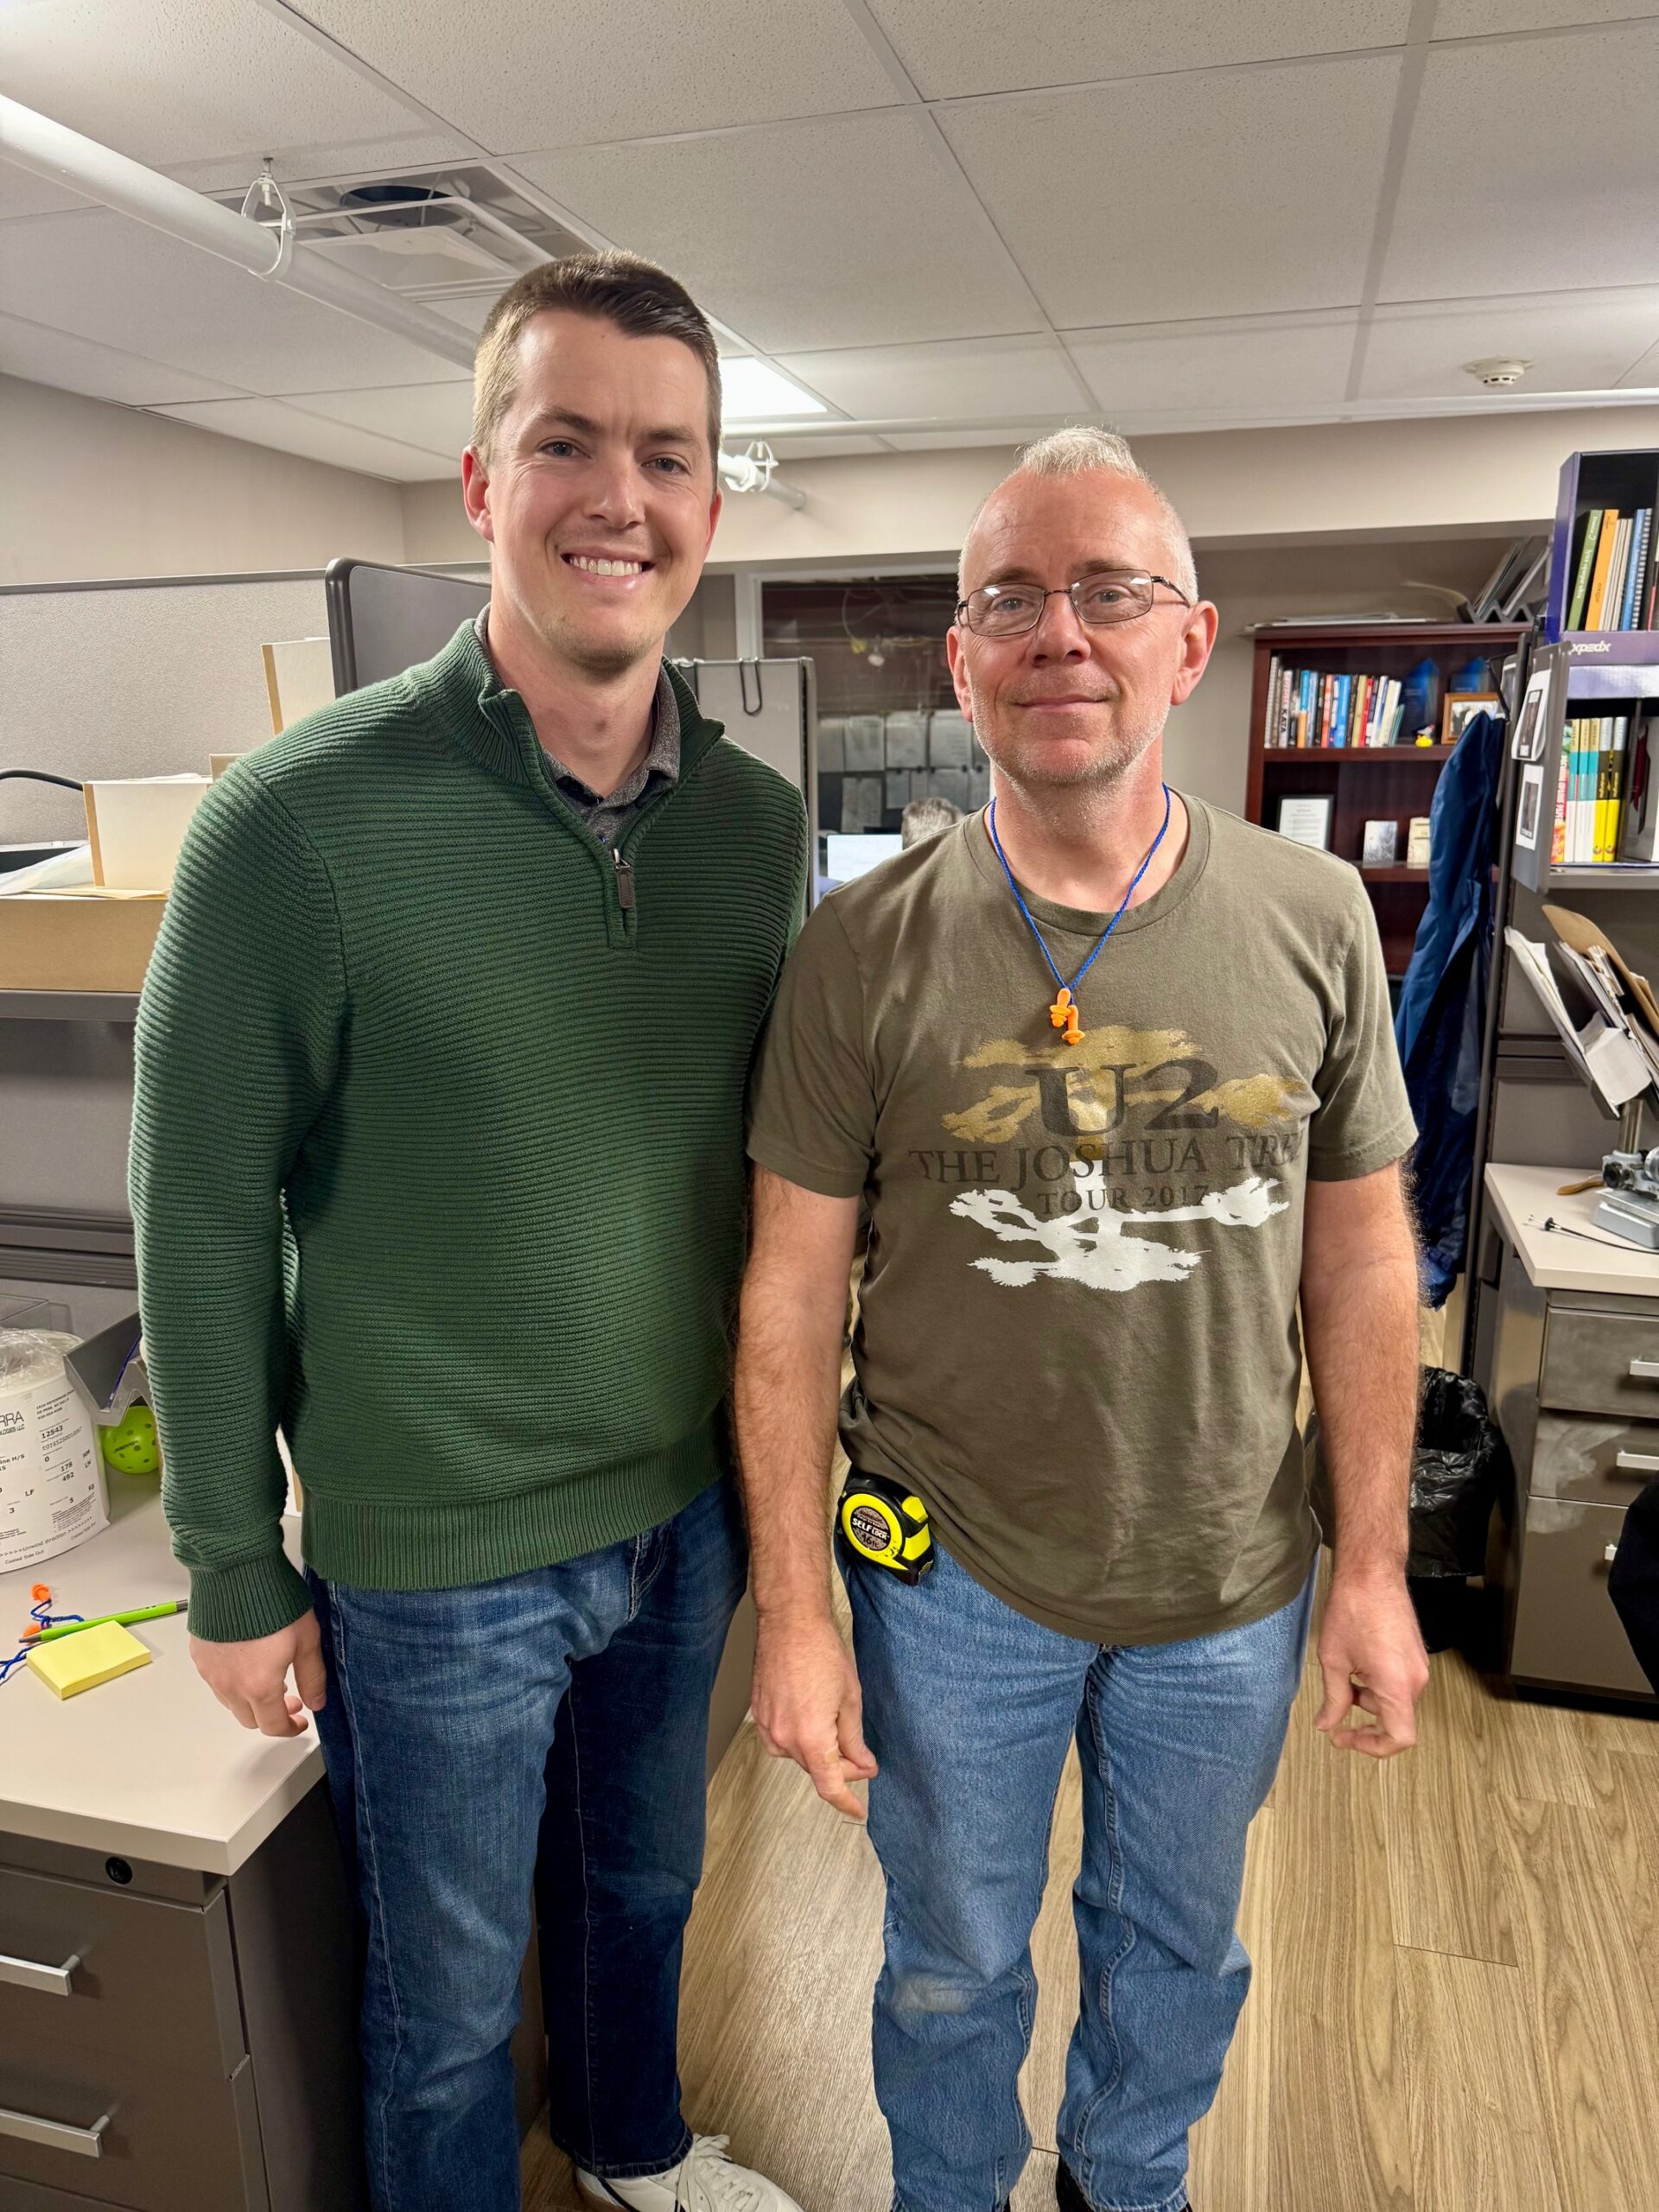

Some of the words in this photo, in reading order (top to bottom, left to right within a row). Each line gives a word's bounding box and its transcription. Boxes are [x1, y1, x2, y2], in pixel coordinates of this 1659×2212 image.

[1568, 640, 1611, 655] xpedx
[1025, 1058, 1219, 1136] U2
[908, 1150, 1001, 1183] THE
[1010, 1138, 1210, 1192] JOSHUA
[1038, 1187, 1130, 1215] TOUR
[1141, 1185, 1210, 1207] 2017
[41, 1425, 63, 1439] 12543
[852, 1517, 873, 1532] SELF
[871, 1527, 887, 1540] LOCK
